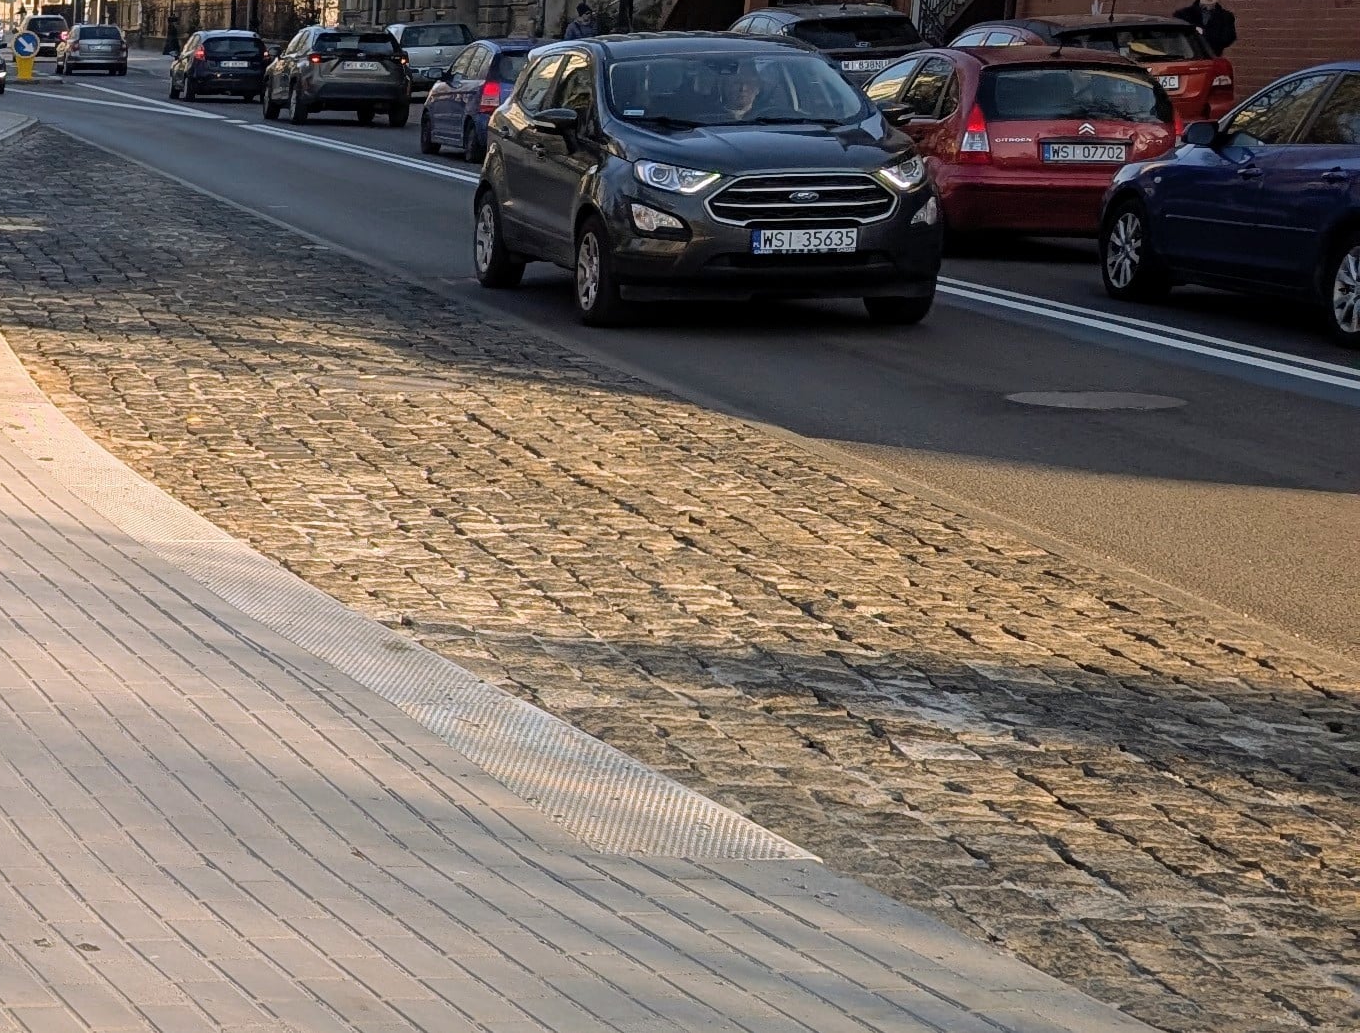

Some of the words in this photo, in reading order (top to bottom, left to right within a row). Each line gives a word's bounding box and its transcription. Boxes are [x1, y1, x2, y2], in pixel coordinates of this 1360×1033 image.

[1051, 145, 1076, 159] WSI
[1082, 146, 1123, 160] 07702
[763, 231, 793, 248] WSI
[801, 230, 855, 248] 35635
